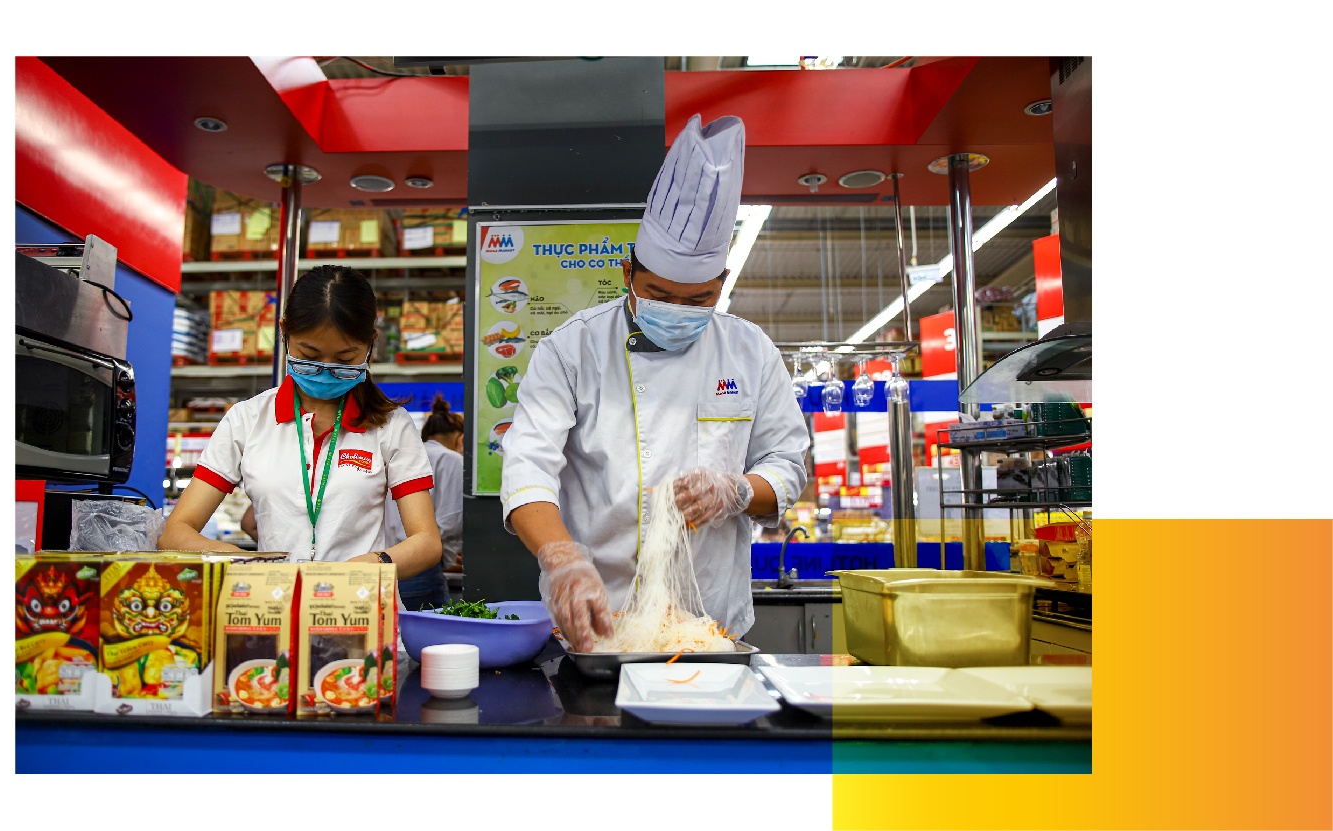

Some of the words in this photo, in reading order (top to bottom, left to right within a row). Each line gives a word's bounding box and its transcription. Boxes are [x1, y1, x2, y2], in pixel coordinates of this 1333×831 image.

[533, 244, 575, 259] THỰC
[579, 236, 624, 256] PHẨM
[560, 258, 586, 269] CHO
[225, 612, 252, 626] Tom
[254, 612, 282, 626] Yum
[309, 612, 337, 626] Tom
[341, 612, 370, 626] Yum
